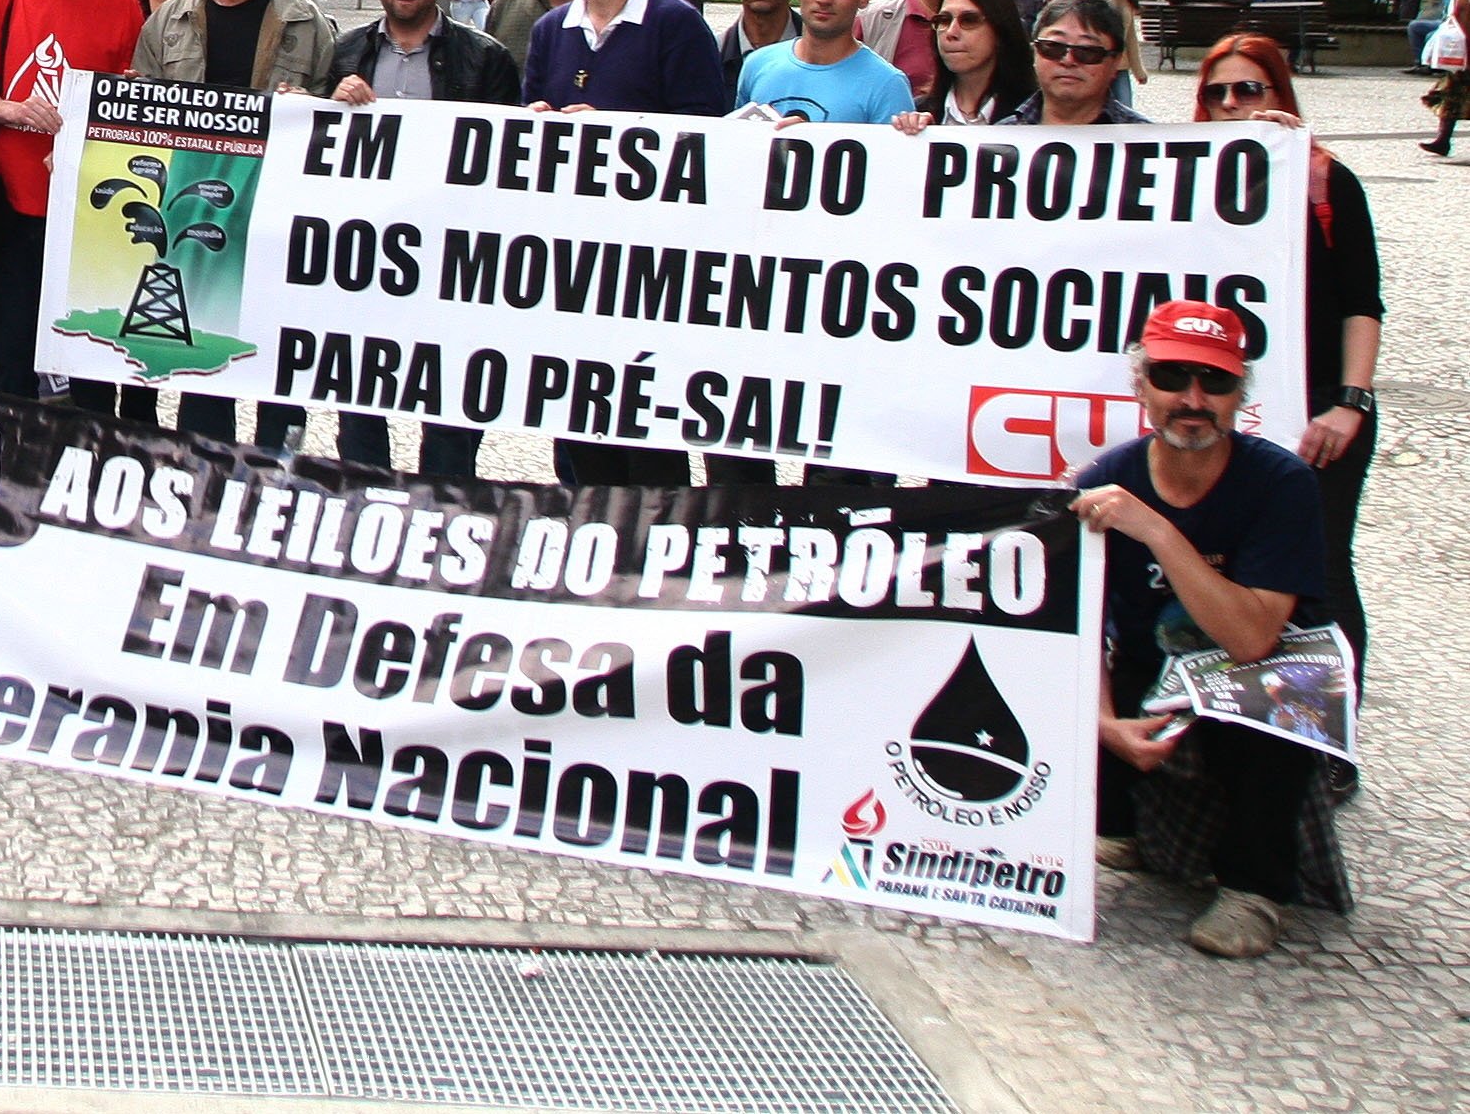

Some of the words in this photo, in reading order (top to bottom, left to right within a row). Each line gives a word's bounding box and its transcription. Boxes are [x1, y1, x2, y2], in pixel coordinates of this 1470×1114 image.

[97, 79, 111, 97] O
[116, 83, 218, 108] PETRÓLEO
[222, 92, 265, 113] TEM
[97, 100, 138, 121] QUE
[142, 106, 180, 126] SER
[184, 112, 260, 134] NOSSO!
[142, 130, 173, 146] 100%
[175, 136, 213, 151] ESTATAL
[303, 110, 403, 181] EM
[445, 116, 707, 205] DEFESA
[763, 137, 868, 216] DO
[922, 138, 1271, 226] PROJETO
[285, 215, 423, 298] DOS
[438, 228, 919, 343] MOVIMENTOS
[274, 326, 442, 417] PARA
[462, 347, 508, 424] O
[523, 350, 842, 460] PRÉ-SAL!
[39, 444, 195, 539] AOS
[209, 480, 495, 587] LEILÕES
[510, 517, 619, 597] DO
[637, 506, 1047, 617] PETRÓLEO
[120, 562, 270, 676] Em
[282, 593, 636, 719] Defesa
[666, 630, 805, 738] da
[885, 740, 903, 757] O
[314, 720, 801, 878] Nacional
[888, 760, 985, 827] PETRÓLEO
[989, 805, 1005, 825] É
[1005, 761, 1053, 822] NOSSO
[881, 842, 1068, 899] Sindipetro
